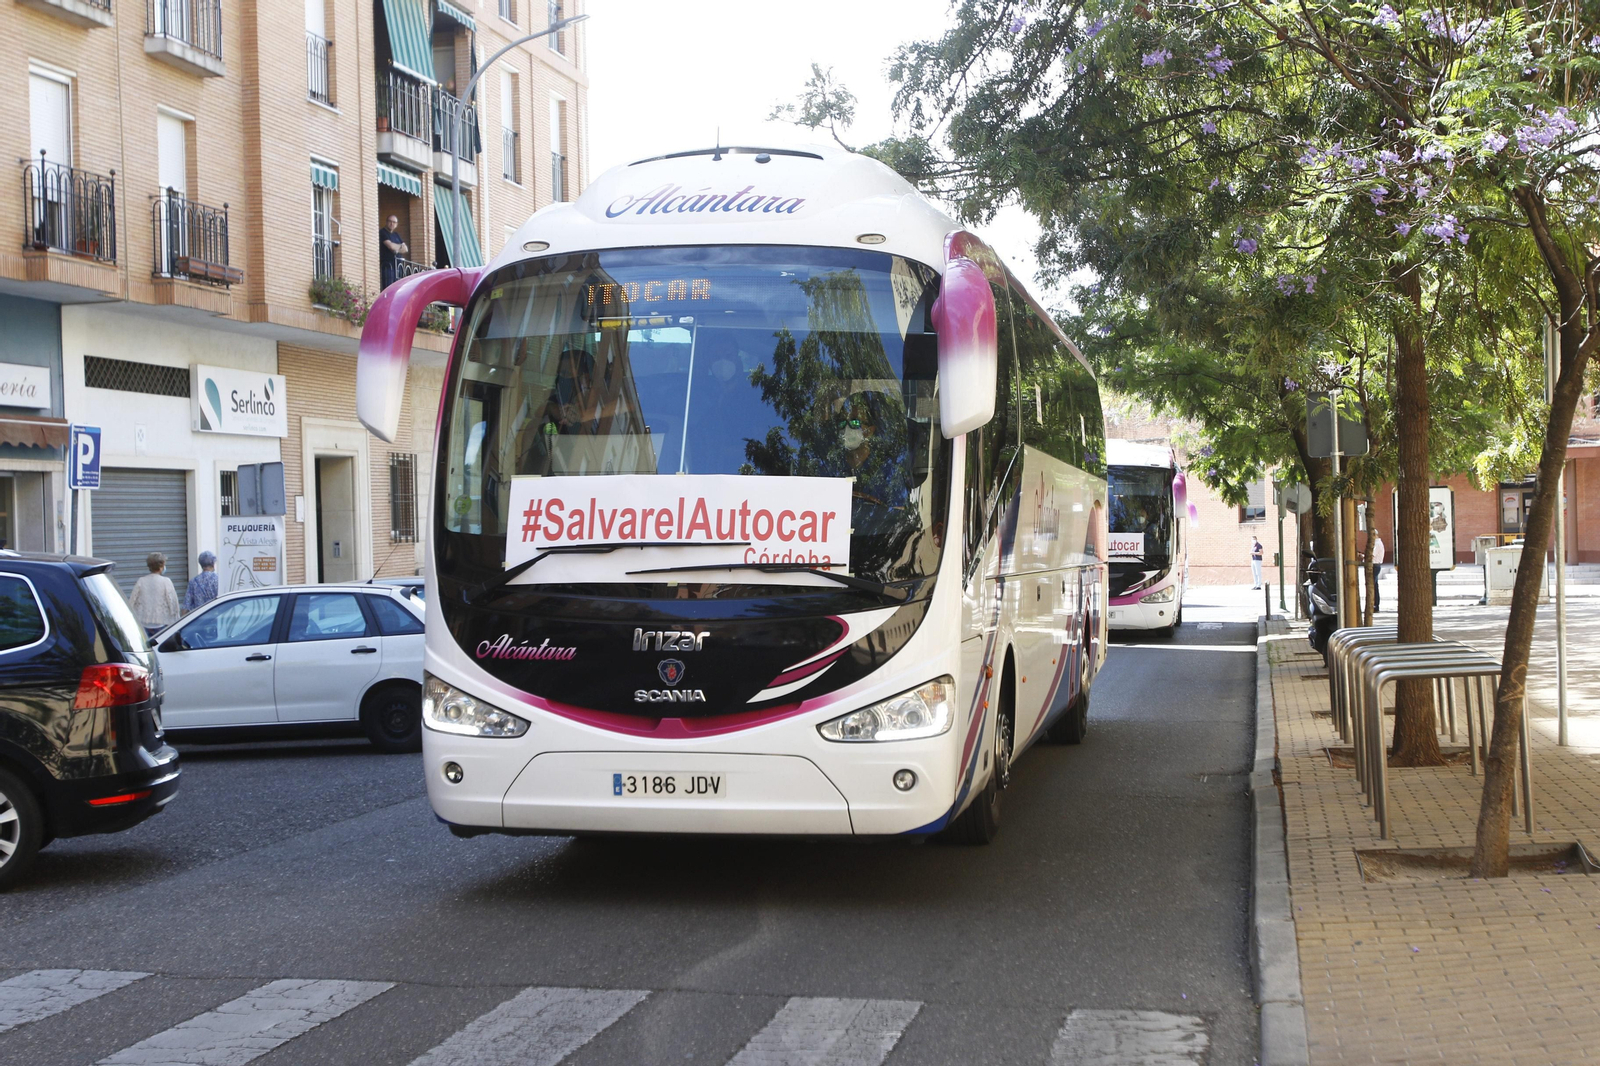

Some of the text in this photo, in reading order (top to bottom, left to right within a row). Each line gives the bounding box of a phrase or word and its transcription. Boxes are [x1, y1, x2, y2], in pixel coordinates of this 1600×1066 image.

[606, 183, 806, 218] Alcántara
[231, 389, 275, 416] Serlinco
[77, 433, 95, 480] P
[227, 523, 276, 532] PELUQUERÍA
[522, 497, 836, 543] #SalvarelAutocar
[743, 547, 832, 570] Córdoba
[475, 633, 578, 660] Alcántara
[632, 627, 711, 651] Irizar
[633, 689, 707, 703] SCANIA
[627, 776, 676, 794] 3186
[684, 776, 721, 795] JDV
